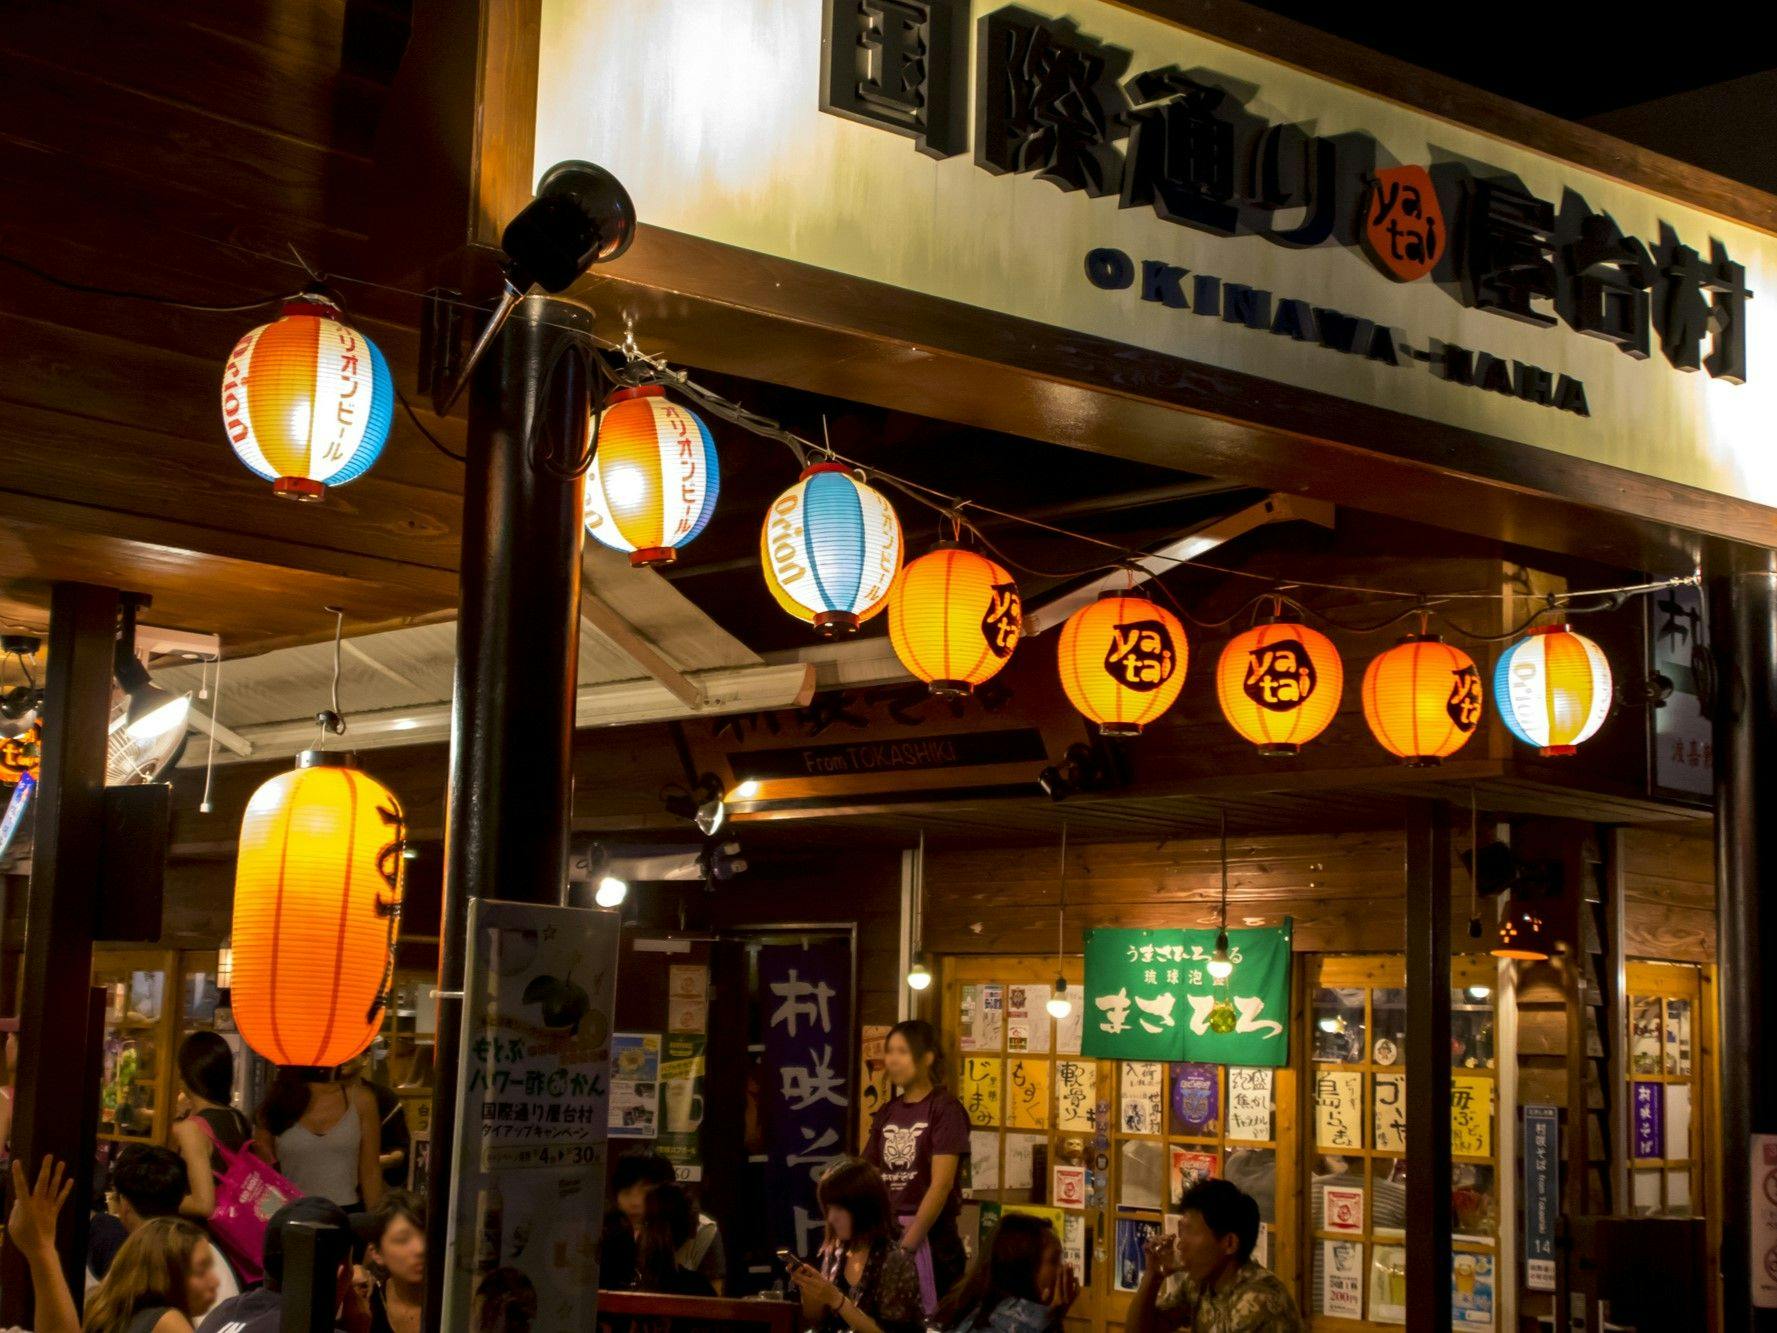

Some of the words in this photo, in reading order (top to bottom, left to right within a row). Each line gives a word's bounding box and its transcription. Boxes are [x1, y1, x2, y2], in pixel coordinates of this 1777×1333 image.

[1109, 627, 1162, 662] ya
[1122, 650, 1172, 684] tai
[1246, 649, 1297, 685] ya
[1259, 666, 1309, 703] tai
[481, 1102, 594, 1124] 国際通り屋台村
